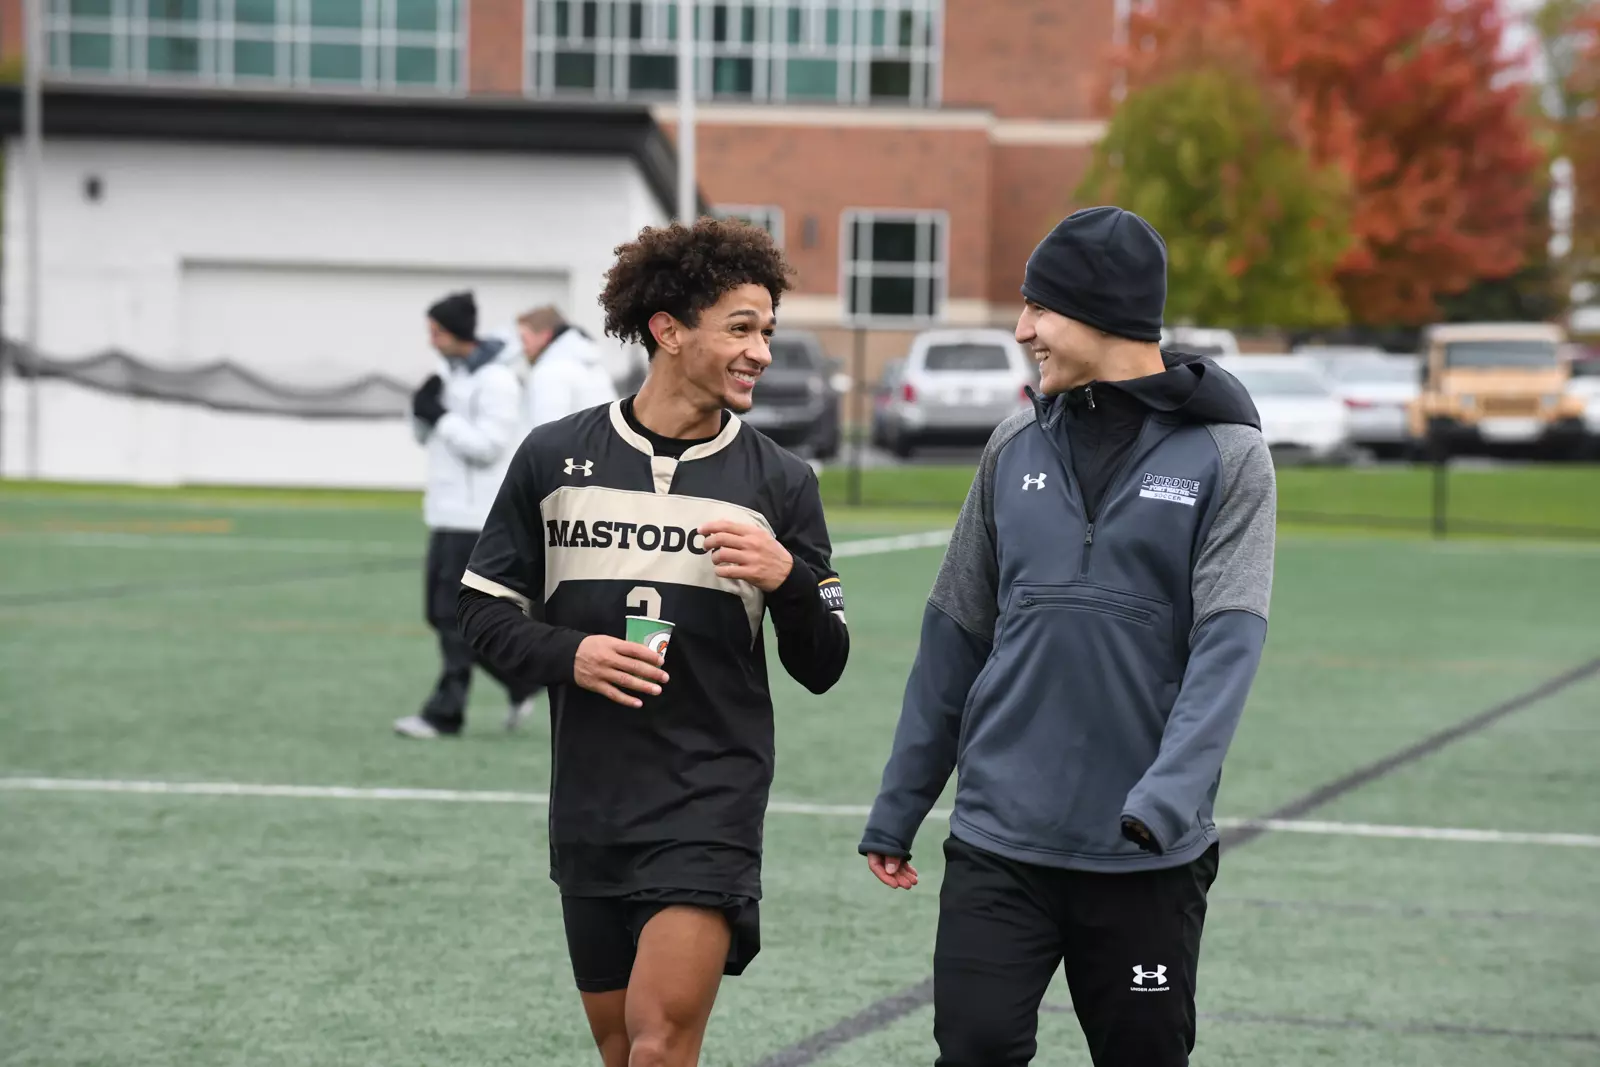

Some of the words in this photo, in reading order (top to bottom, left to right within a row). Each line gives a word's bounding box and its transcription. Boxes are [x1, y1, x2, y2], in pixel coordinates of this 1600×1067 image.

[1143, 473, 1200, 492] PURDUE
[1154, 492, 1182, 501] SOCCER
[546, 519, 720, 555] MASTODO
